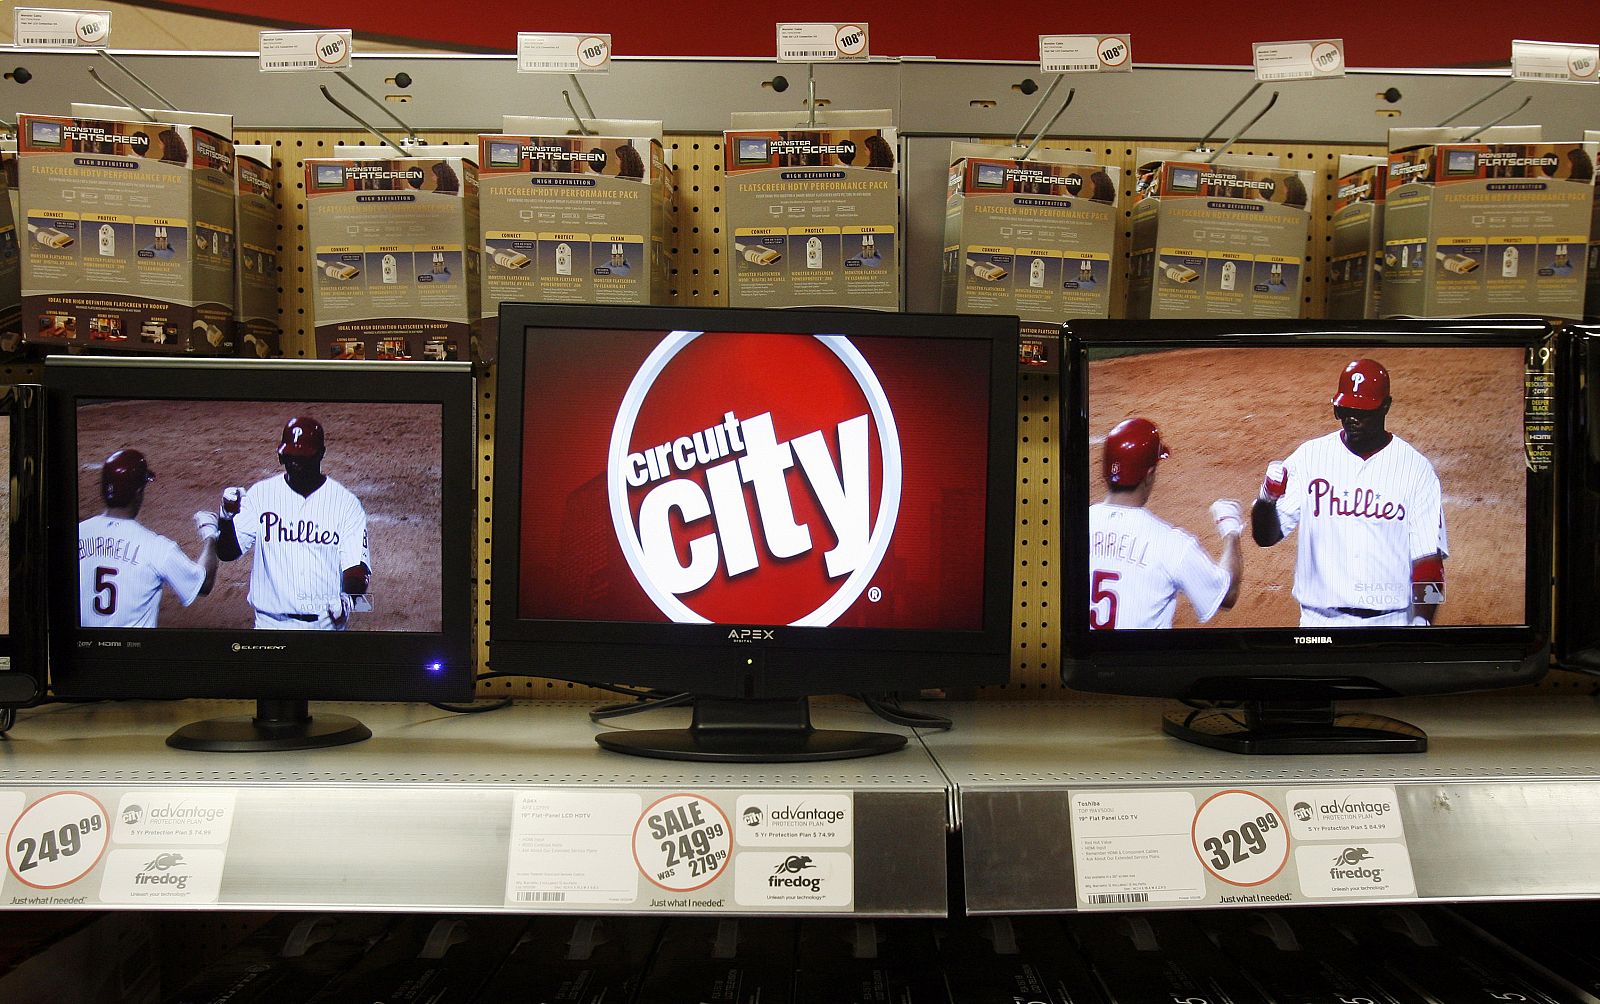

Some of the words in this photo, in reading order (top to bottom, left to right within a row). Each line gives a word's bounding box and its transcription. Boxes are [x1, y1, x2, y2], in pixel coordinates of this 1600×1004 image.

[63, 126, 105, 134] MONSTER
[63, 132, 148, 145] FLATSCREEN
[770, 145, 854, 154] FLATSCREEN
[521, 152, 605, 162] FLATSCREEN
[1478, 158, 1557, 167] FLATSCREEN
[31, 165, 79, 176] FLATSCREEN
[104, 170, 160, 183] PERFORMANCE
[346, 171, 422, 180] FLATSCREEN
[1006, 168, 1043, 176] MONSTER
[739, 183, 785, 192] FLATSCREEN
[788, 182, 809, 191] HDTV
[811, 182, 866, 191] PERFORMANCE
[869, 181, 888, 189] PACK
[1006, 174, 1081, 186] FLATSCREEN
[1201, 178, 1274, 190] FLATSCREEN
[490, 187, 535, 196] FLATSCREEN
[538, 188, 559, 196] HDTV
[561, 189, 616, 199] PERFORMANCE
[619, 191, 638, 199] PACK
[1352, 373, 1365, 391] P
[293, 427, 303, 442] P
[625, 411, 746, 487] circuit
[638, 411, 869, 594] city
[1308, 478, 1405, 520] Phillies
[260, 511, 340, 546] Phillies
[79, 537, 141, 566] BURRELL
[93, 565, 119, 616] 5
[1089, 569, 1121, 630] 5
[727, 629, 774, 640] APEX
[1294, 636, 1333, 644] TOSHIBA
[122, 808, 143, 824] city
[151, 800, 224, 821] advantage
[743, 811, 763, 825] city
[771, 801, 844, 824] advantage
[1294, 807, 1313, 820] city
[1320, 795, 1391, 816] advantage
[647, 800, 705, 841] SALE
[135, 873, 189, 889] firedog
[657, 868, 675, 881] was
[1329, 868, 1382, 882] firedog
[768, 876, 820, 892] firedog
[10, 896, 28, 905] Just
[28, 896, 49, 905] what
[650, 899, 667, 907] Just
[668, 899, 688, 907] what
[1220, 895, 1236, 904] Just
